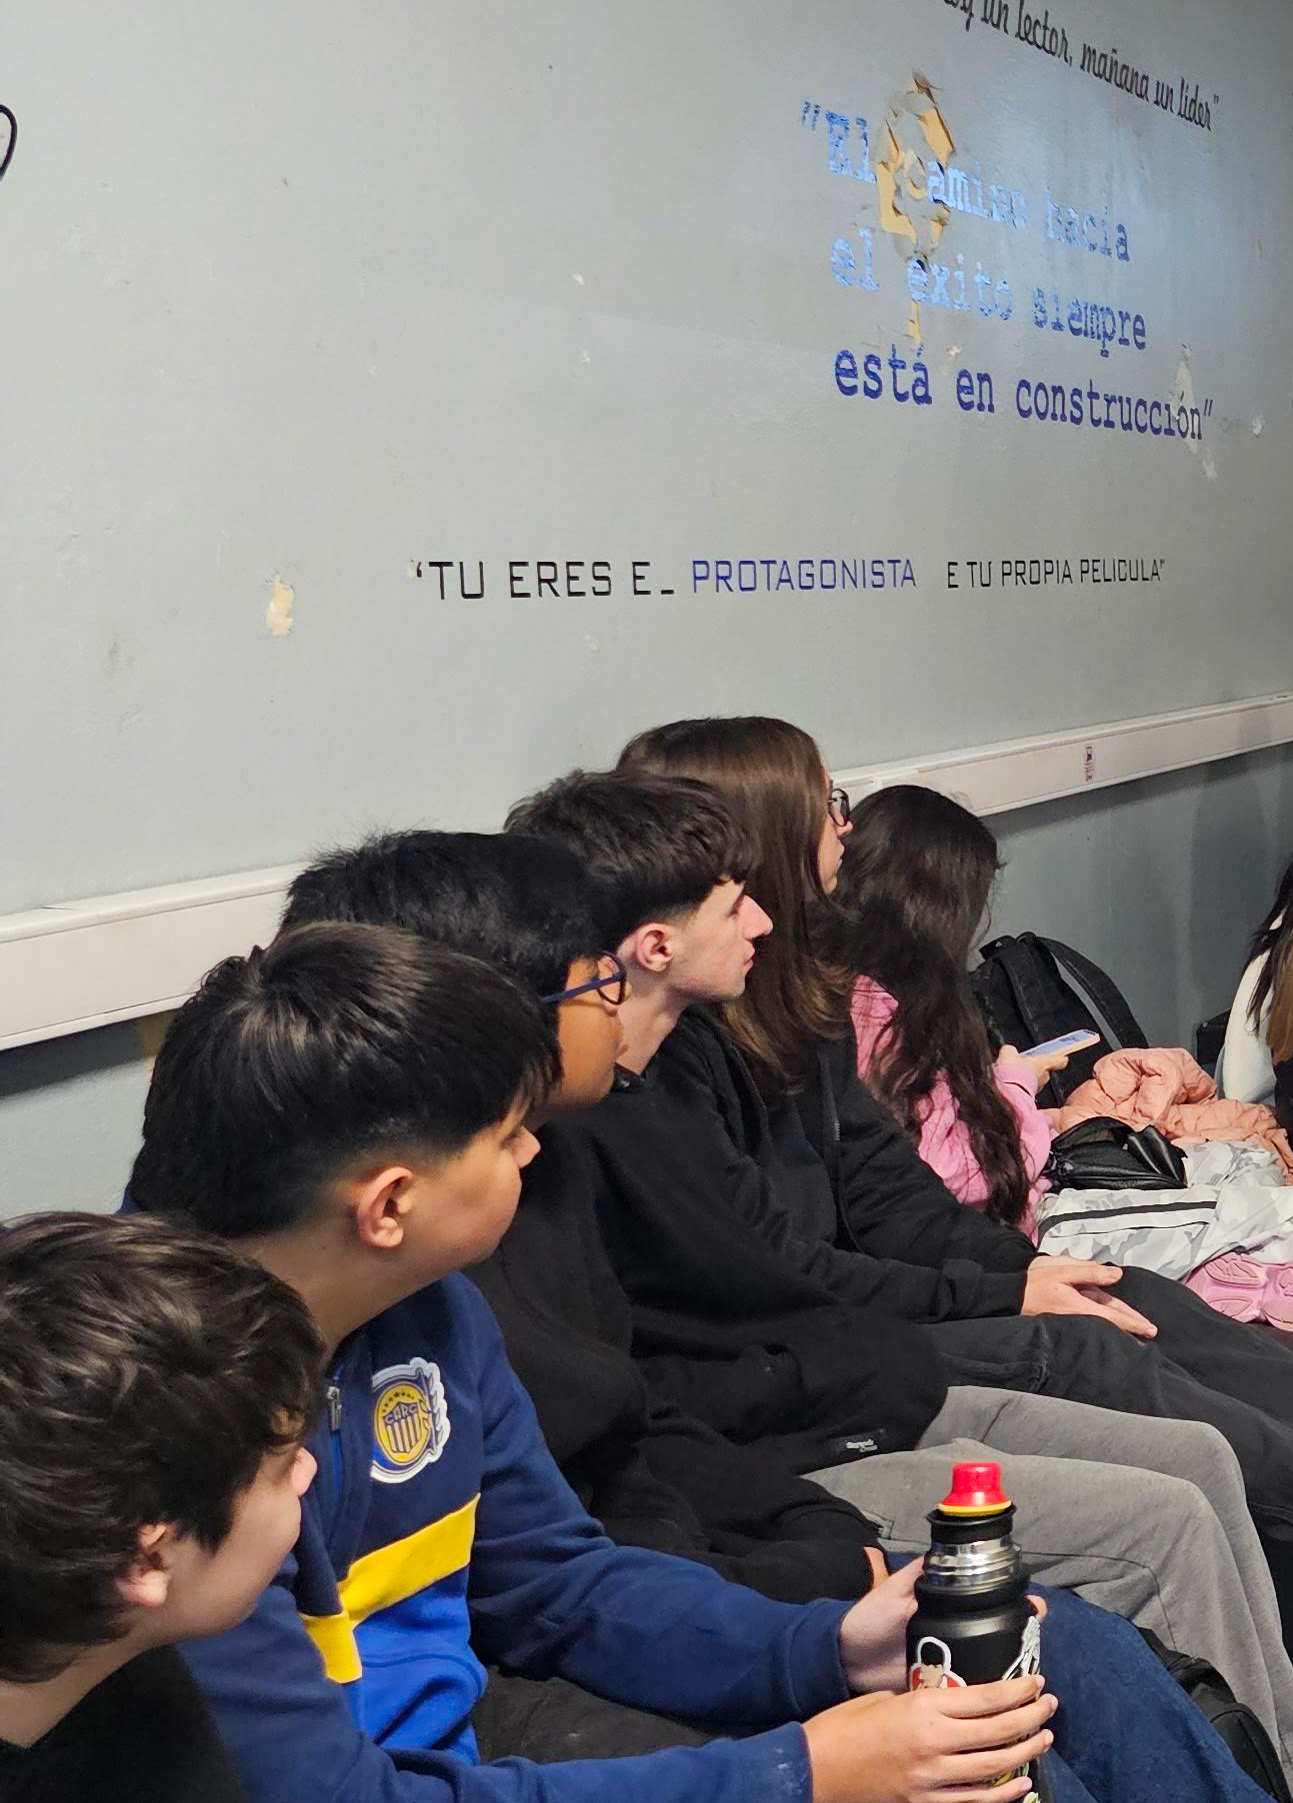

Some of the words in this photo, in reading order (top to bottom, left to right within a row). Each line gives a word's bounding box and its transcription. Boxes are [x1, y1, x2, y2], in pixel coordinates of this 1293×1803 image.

[1014, 0, 1073, 67] lector,
[1080, 41, 1151, 103] mañana
[1153, 79, 1174, 113] un
[831, 226, 880, 292] el
[1032, 287, 1147, 358] siempre
[834, 344, 933, 406] está
[956, 368, 995, 413] en
[508, 561, 612, 599] ERES
[691, 558, 918, 594] PROTAGONISTA
[966, 560, 993, 588] TU
[1001, 559, 1074, 587] PROPIA
